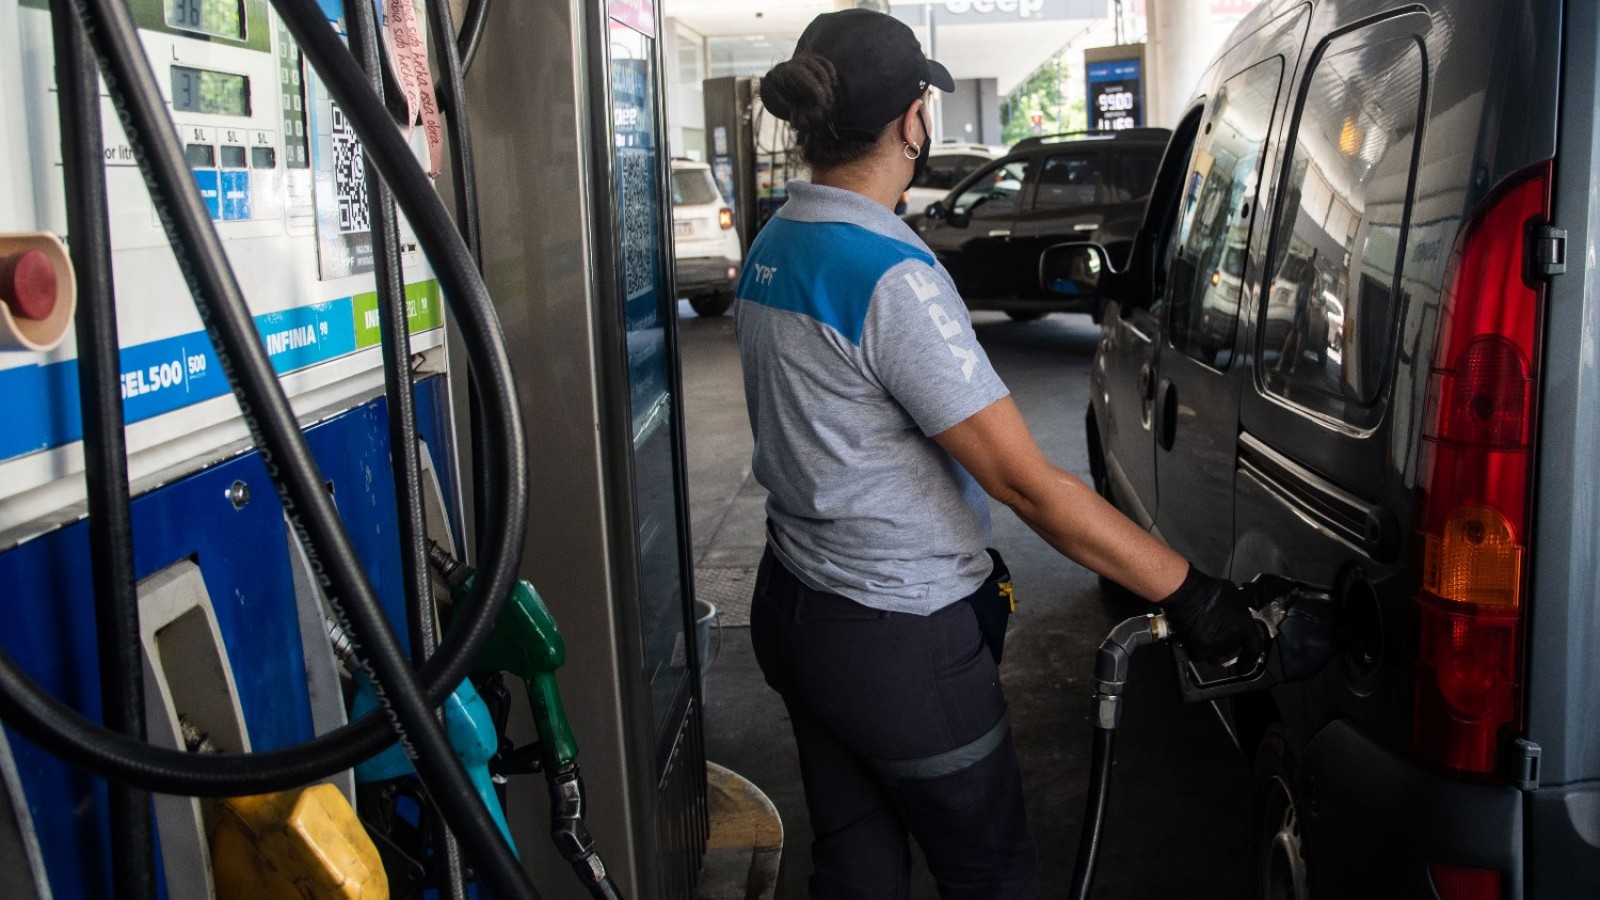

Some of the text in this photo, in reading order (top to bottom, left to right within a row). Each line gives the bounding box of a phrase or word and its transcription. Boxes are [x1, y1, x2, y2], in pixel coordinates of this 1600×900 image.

[394, 27, 410, 48] sido
[409, 27, 423, 47] sido
[172, 44, 179, 61] L
[398, 54, 415, 90] hecha
[412, 53, 430, 87] hecha
[420, 89, 435, 115] esta
[194, 128, 206, 142] S/L
[227, 130, 239, 143] S/L
[258, 132, 268, 145] S/L
[754, 263, 777, 286] YPF
[903, 271, 980, 383] YPF
[266, 325, 317, 356] INFINIA
[187, 353, 207, 374] 500
[121, 360, 183, 400] SEL500
